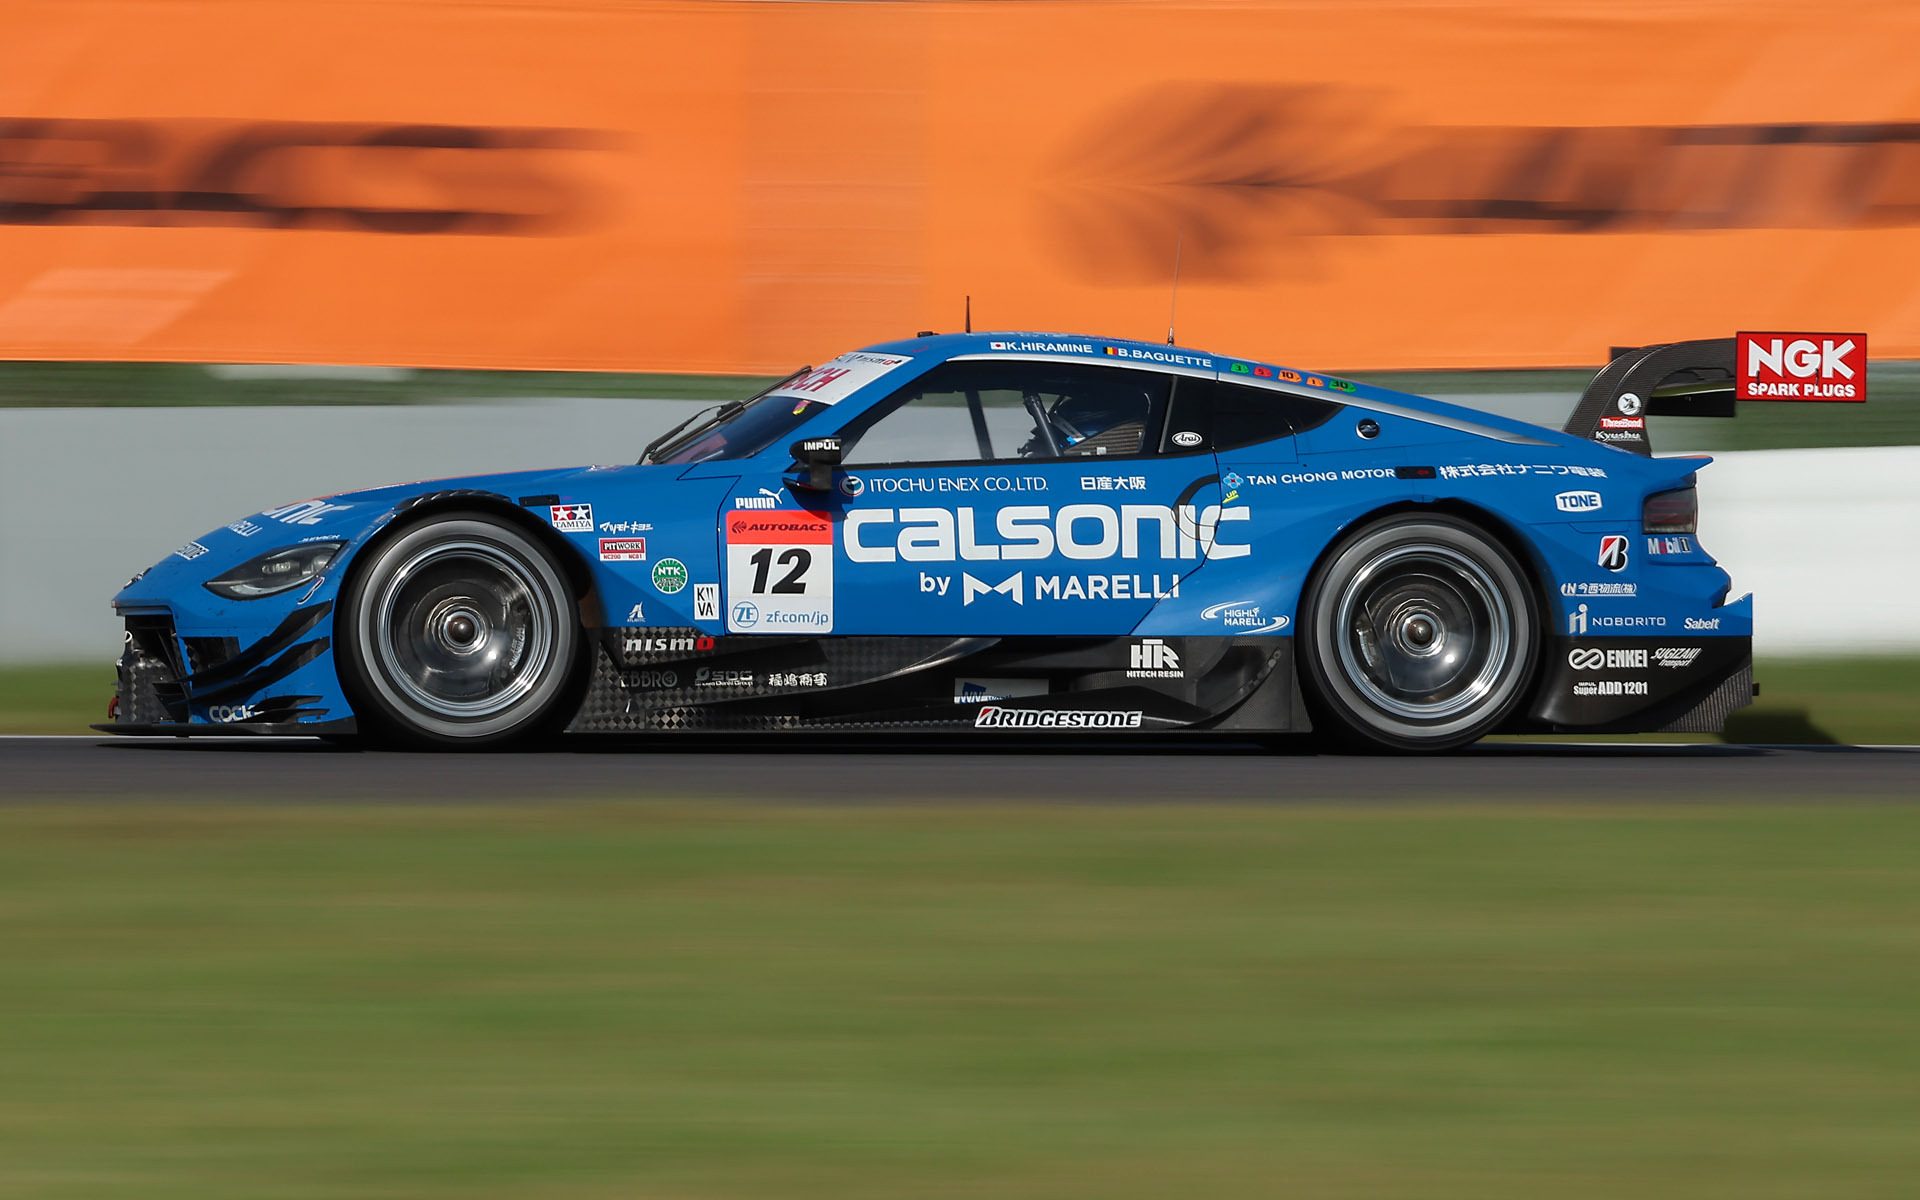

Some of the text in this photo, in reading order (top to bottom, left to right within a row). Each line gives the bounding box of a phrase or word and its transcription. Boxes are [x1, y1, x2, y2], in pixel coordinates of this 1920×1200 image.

[1005, 341, 1093, 353] K.HIRAMINE
[1118, 348, 1212, 368] B.BAGUETTE
[1748, 339, 1855, 379] NGK
[1282, 371, 1294, 379] 10
[1748, 382, 1855, 397] SPARK PLUGS
[1602, 418, 1642, 428] ThreeBond
[1595, 430, 1640, 442] Kyushu
[1247, 468, 1396, 486] TAN CHONG MOTOR
[870, 478, 934, 492] ITOCHU
[938, 478, 979, 492] ENEX
[1080, 477, 1146, 491] 日産大阪
[1226, 490, 1238, 500] UP
[1559, 494, 1599, 508] TONE
[735, 498, 776, 509] PUMA
[554, 520, 592, 528] TAMIYA
[748, 523, 828, 531] AUTOBACS
[1647, 538, 1681, 554] Mobil
[657, 566, 681, 576] NTK
[750, 548, 812, 594] 12
[920, 572, 950, 595] by
[1036, 574, 1179, 601] MARELLI
[766, 610, 829, 625] zf.com/jp
[1224, 608, 1258, 618] HIGHLY
[1224, 616, 1266, 626] MARELLI
[1592, 616, 1666, 626] NOBORITO
[1684, 617, 1720, 630] Sabelt
[625, 637, 714, 651] nismo
[1607, 650, 1648, 668] ENKEI
[1650, 648, 1702, 659] SUGIZAKI
[1126, 670, 1157, 678] HITECH
[1574, 681, 1648, 695] Super ADD 1201
[975, 706, 1142, 728] BRIDGESTONE
